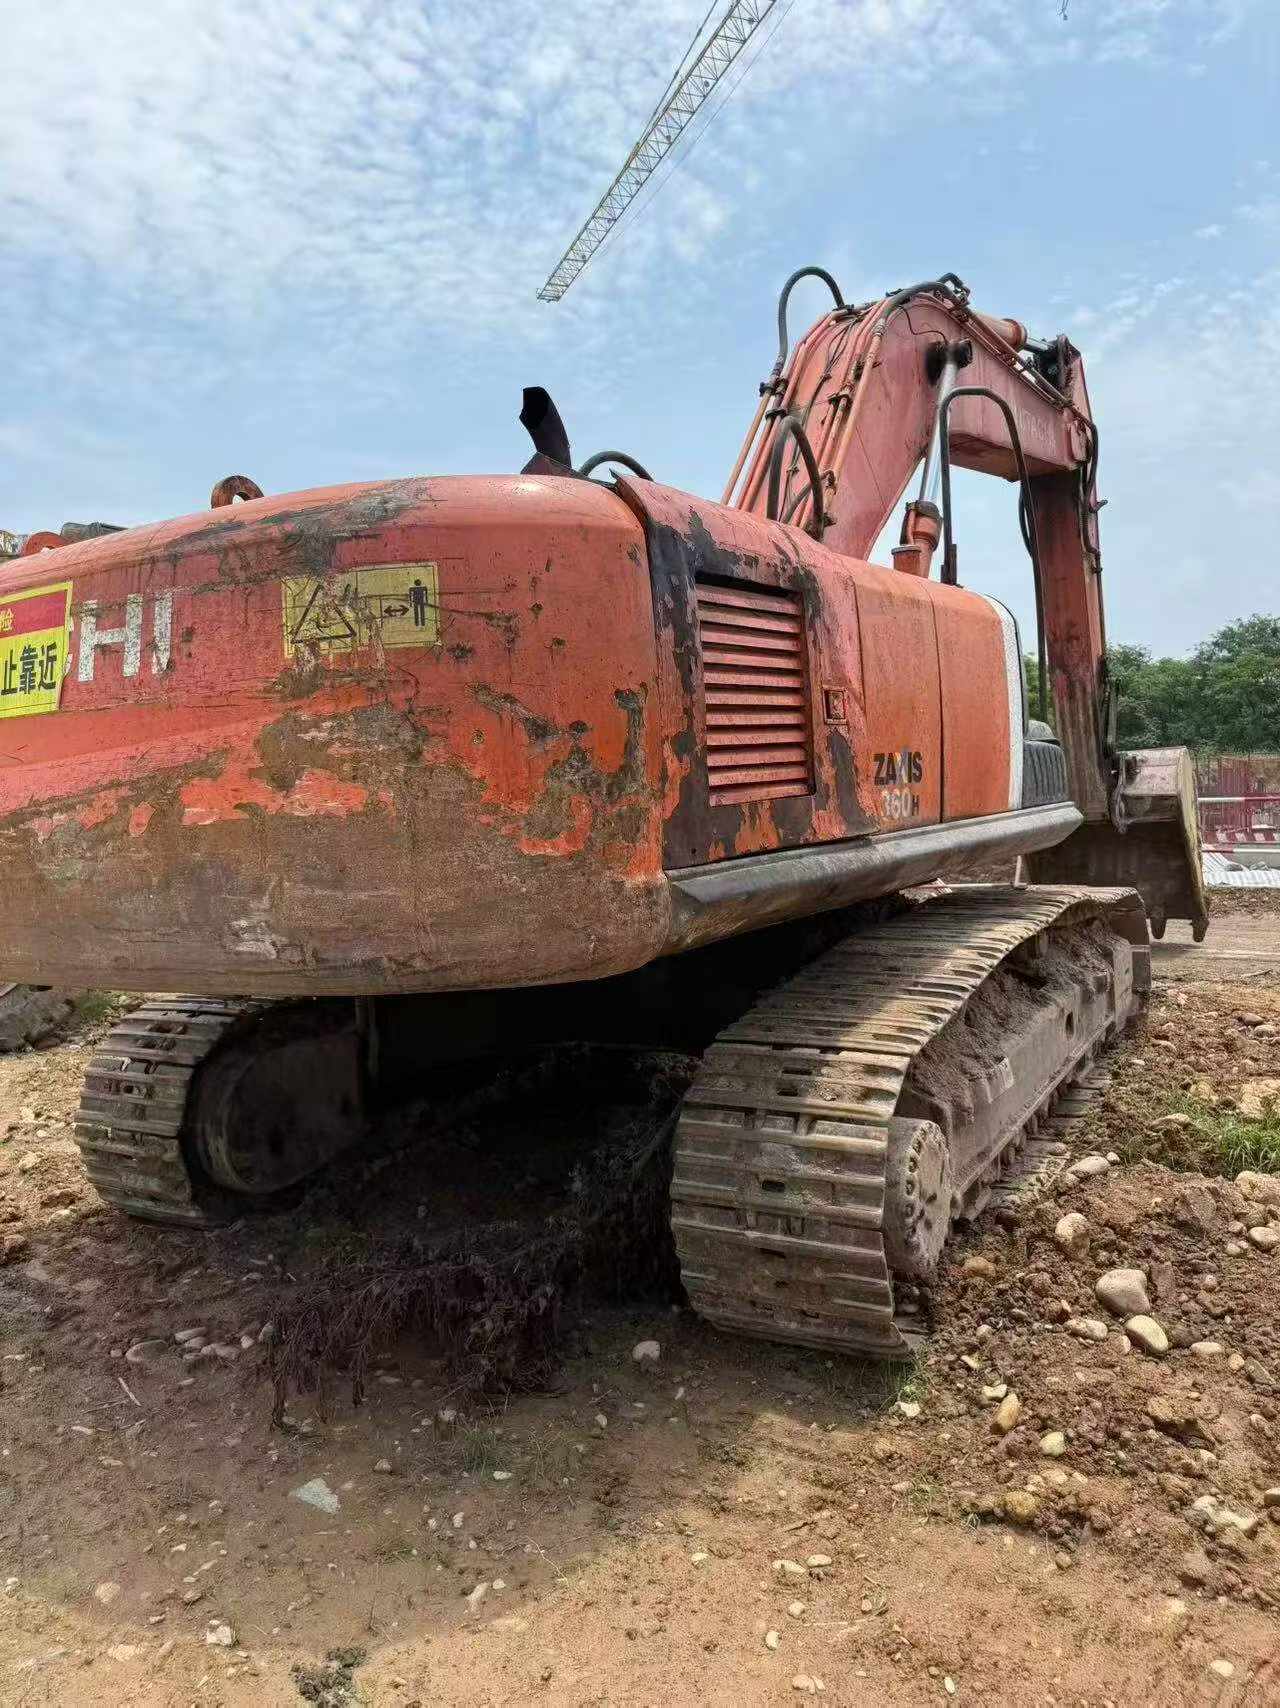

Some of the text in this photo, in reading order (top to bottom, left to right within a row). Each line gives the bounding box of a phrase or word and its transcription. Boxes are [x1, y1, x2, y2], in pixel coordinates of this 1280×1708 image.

[1, 642, 57, 695] 止靠近
[873, 751, 923, 785] ZAXIS
